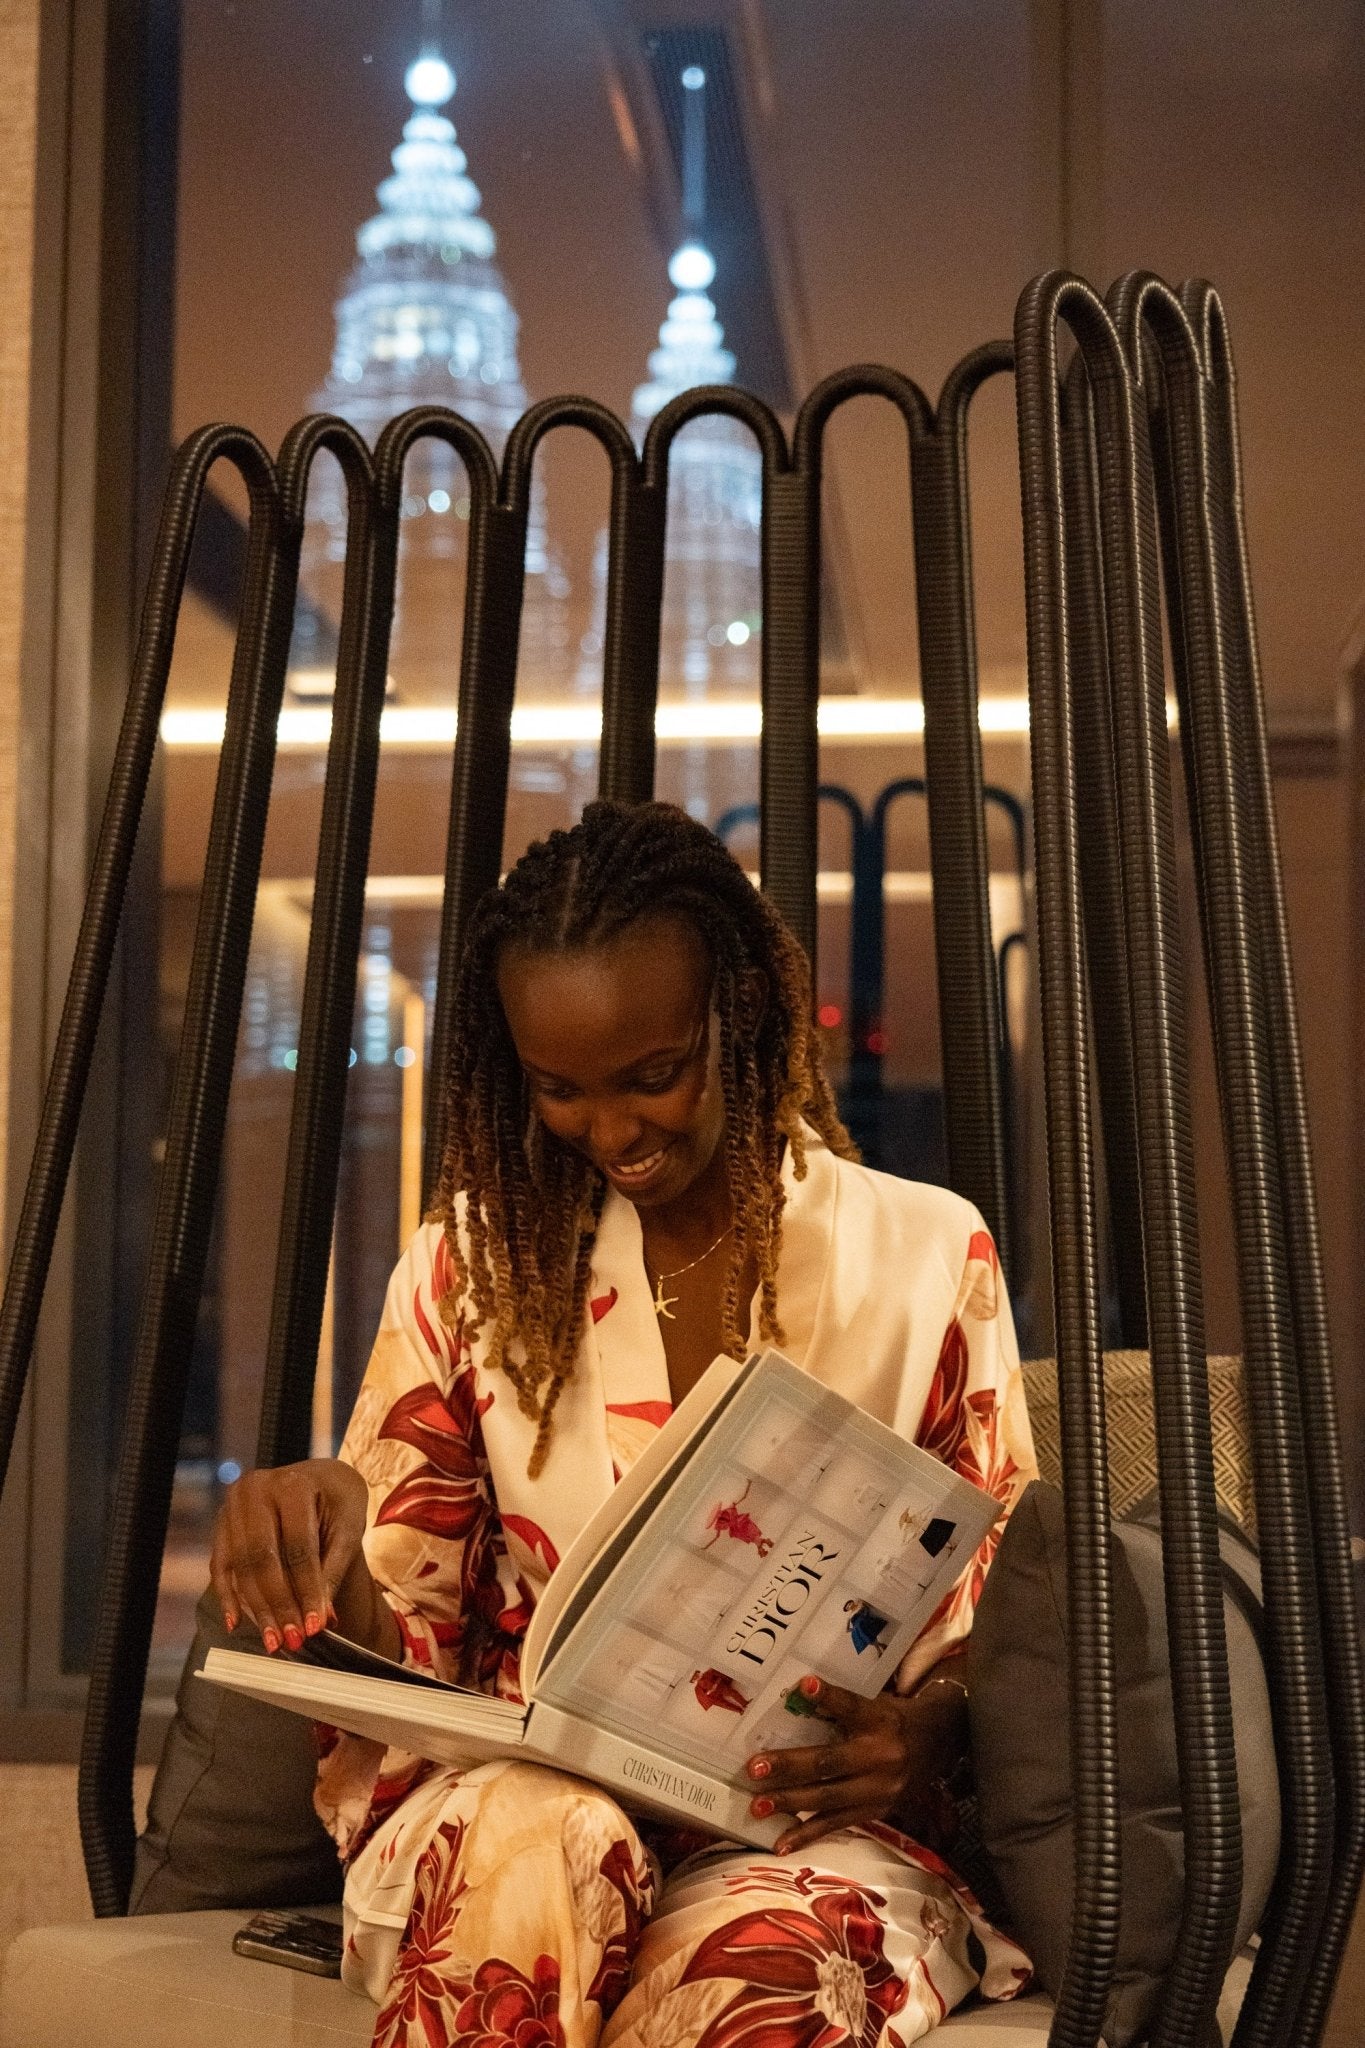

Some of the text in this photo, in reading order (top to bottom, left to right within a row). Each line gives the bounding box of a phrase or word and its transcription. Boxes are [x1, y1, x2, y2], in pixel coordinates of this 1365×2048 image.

[726, 1530, 816, 1653] CHRISTIAN
[737, 1543, 842, 1665] DIOR
[623, 1757, 716, 1811] CHRISTIAN DIOR
